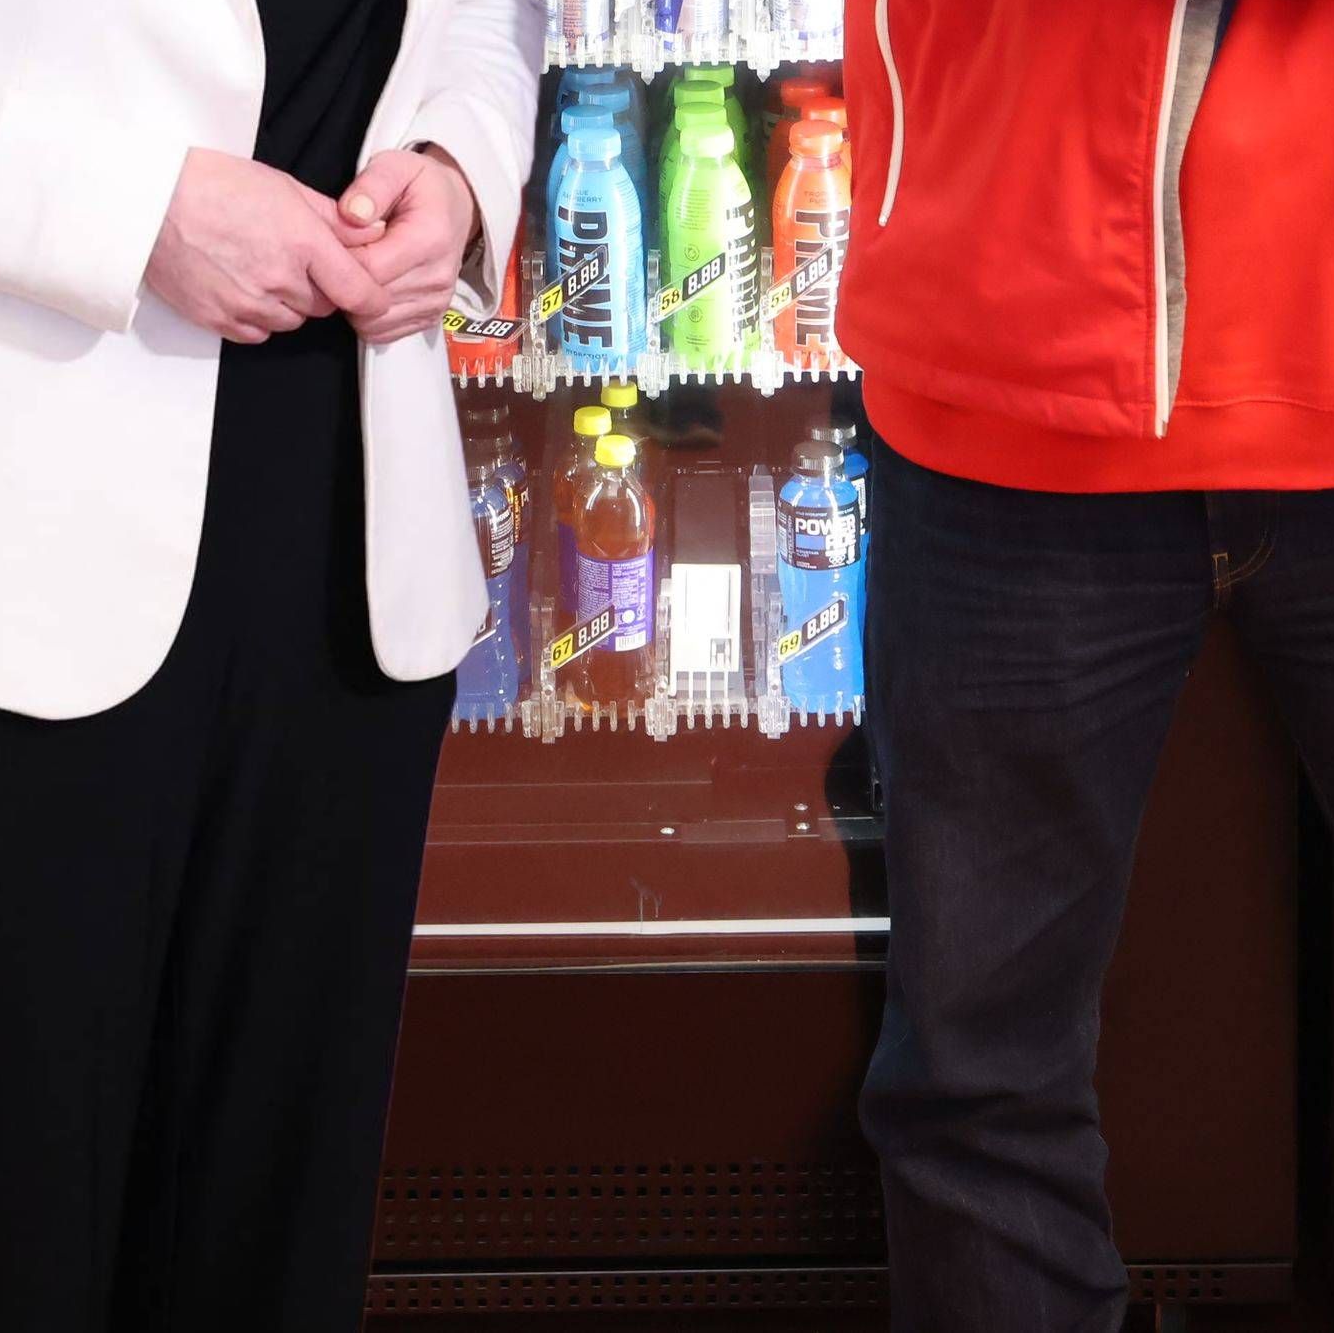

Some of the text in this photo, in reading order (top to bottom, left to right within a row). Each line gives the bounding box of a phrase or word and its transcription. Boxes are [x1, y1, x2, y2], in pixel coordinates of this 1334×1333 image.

[542, 257, 600, 313] 57 8.88
[661, 257, 721, 311] 58 8.88
[771, 254, 828, 308] 59 8.88
[442, 313, 465, 327] 56
[552, 610, 610, 662] 67 8.88
[780, 603, 840, 656] 69 8.88
